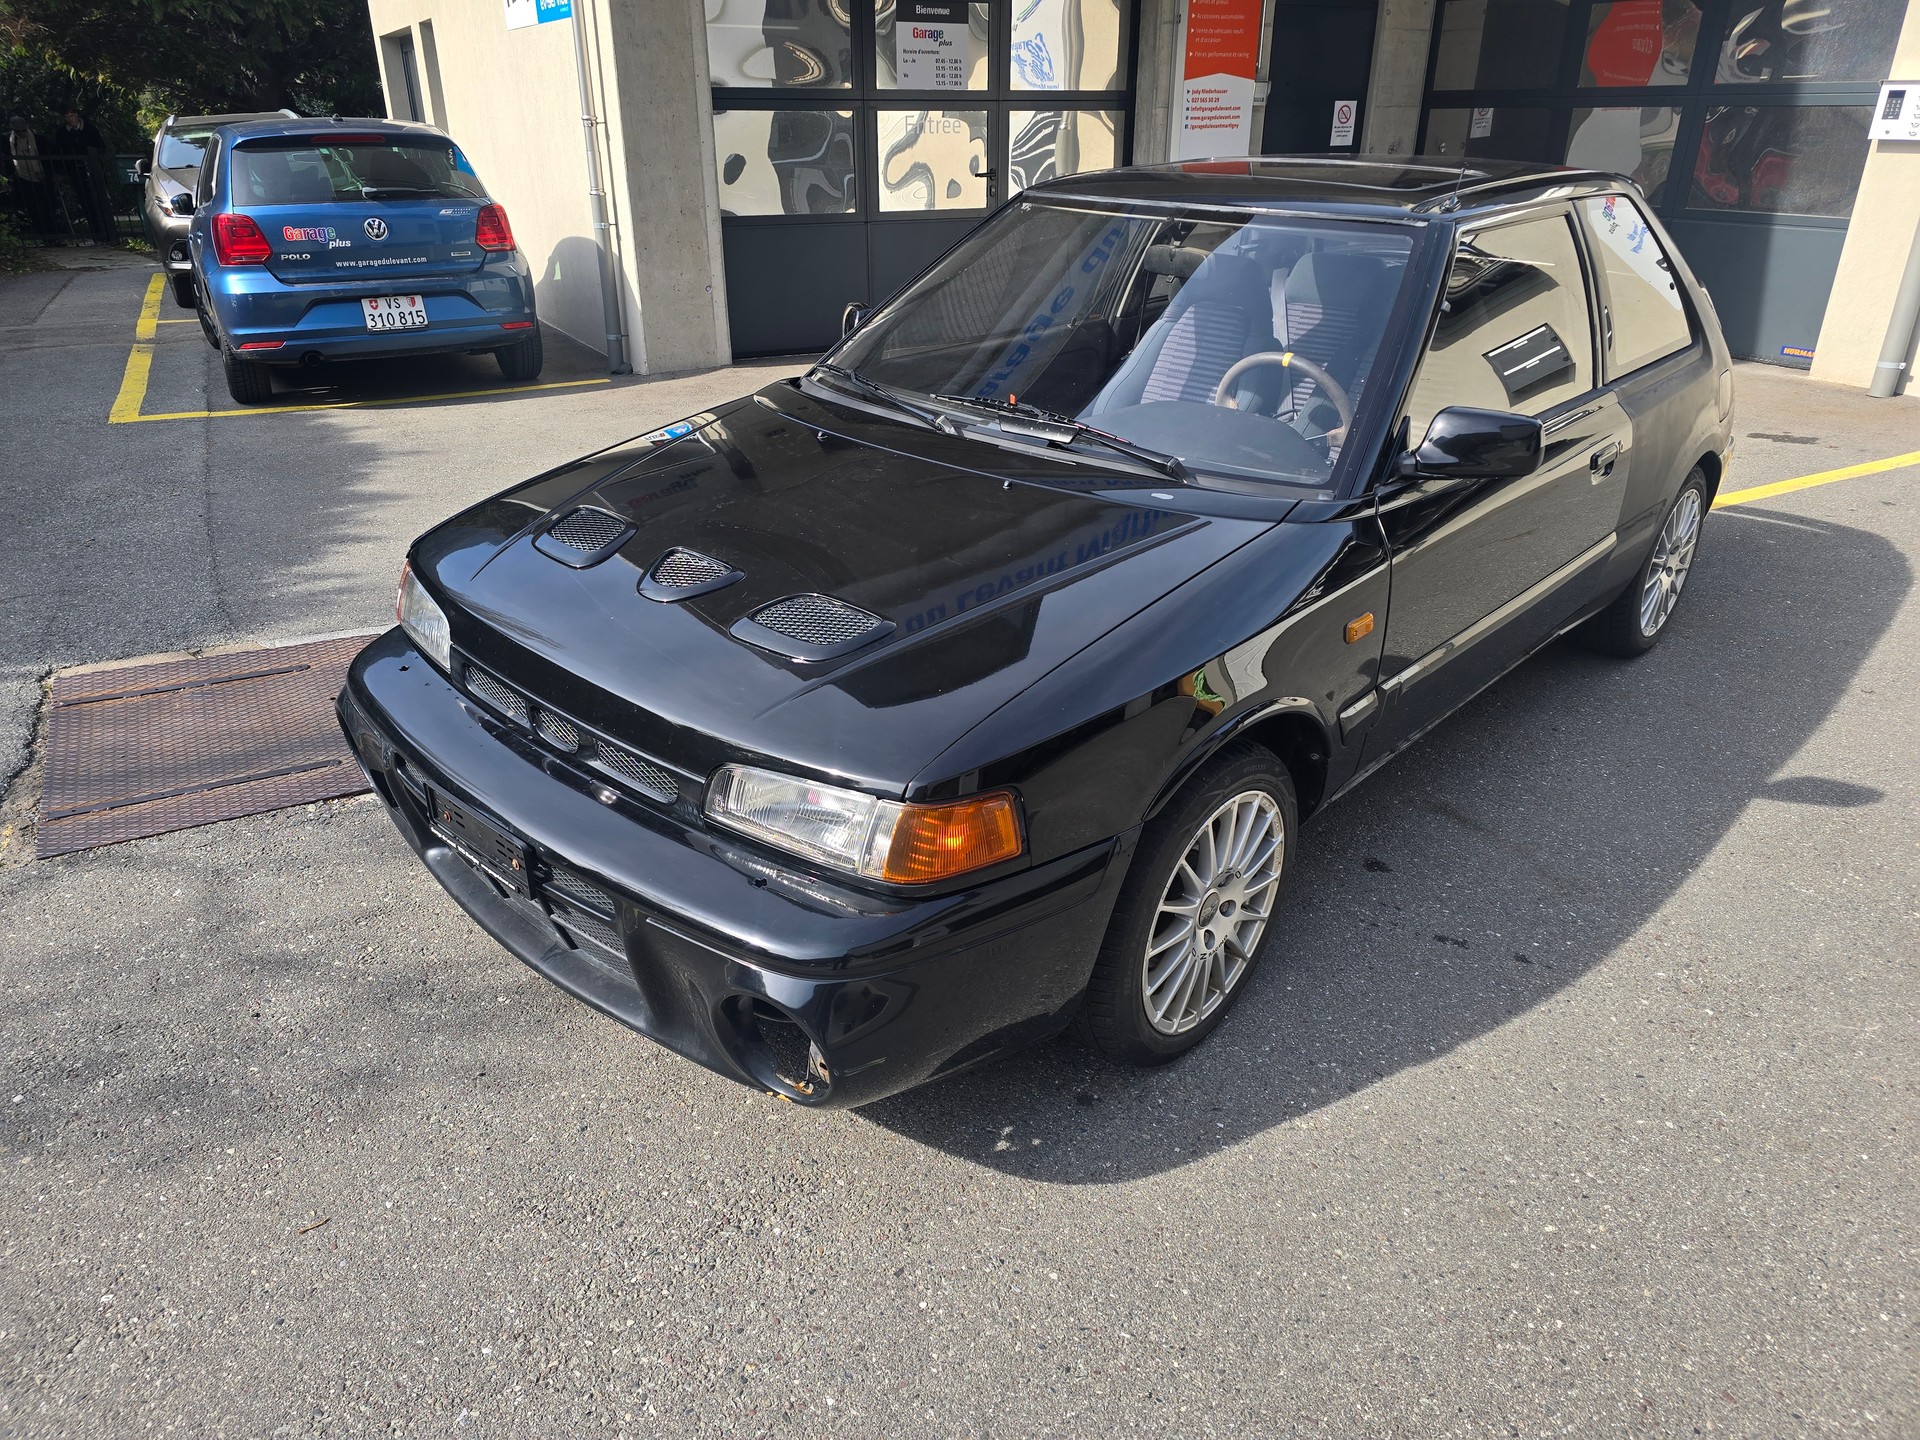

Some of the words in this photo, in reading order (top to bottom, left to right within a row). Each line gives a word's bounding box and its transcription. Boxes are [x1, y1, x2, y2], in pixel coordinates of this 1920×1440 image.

[915, 5, 951, 15] Bienvenue
[912, 27, 944, 42] Garage
[128, 172, 140, 183] 74
[283, 225, 337, 243] Garage
[328, 239, 352, 249] plus
[280, 253, 311, 261] POLO
[335, 256, 428, 268] www.garagedulevant.com
[385, 298, 401, 310] VS
